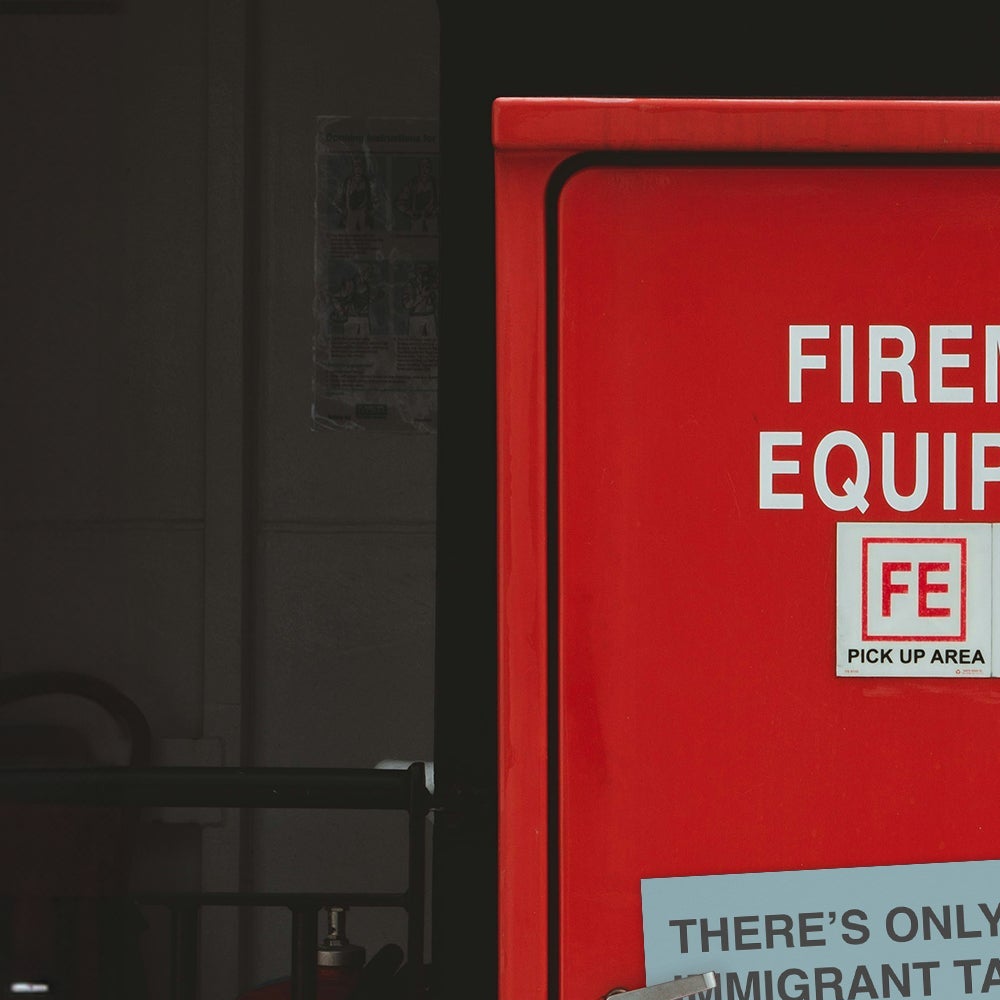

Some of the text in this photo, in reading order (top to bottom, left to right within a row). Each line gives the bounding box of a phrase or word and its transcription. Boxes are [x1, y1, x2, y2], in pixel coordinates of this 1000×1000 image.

[881, 561, 952, 618] FE
[847, 648, 986, 665] PICK UP AREA
[668, 908, 871, 954] THERE’S
